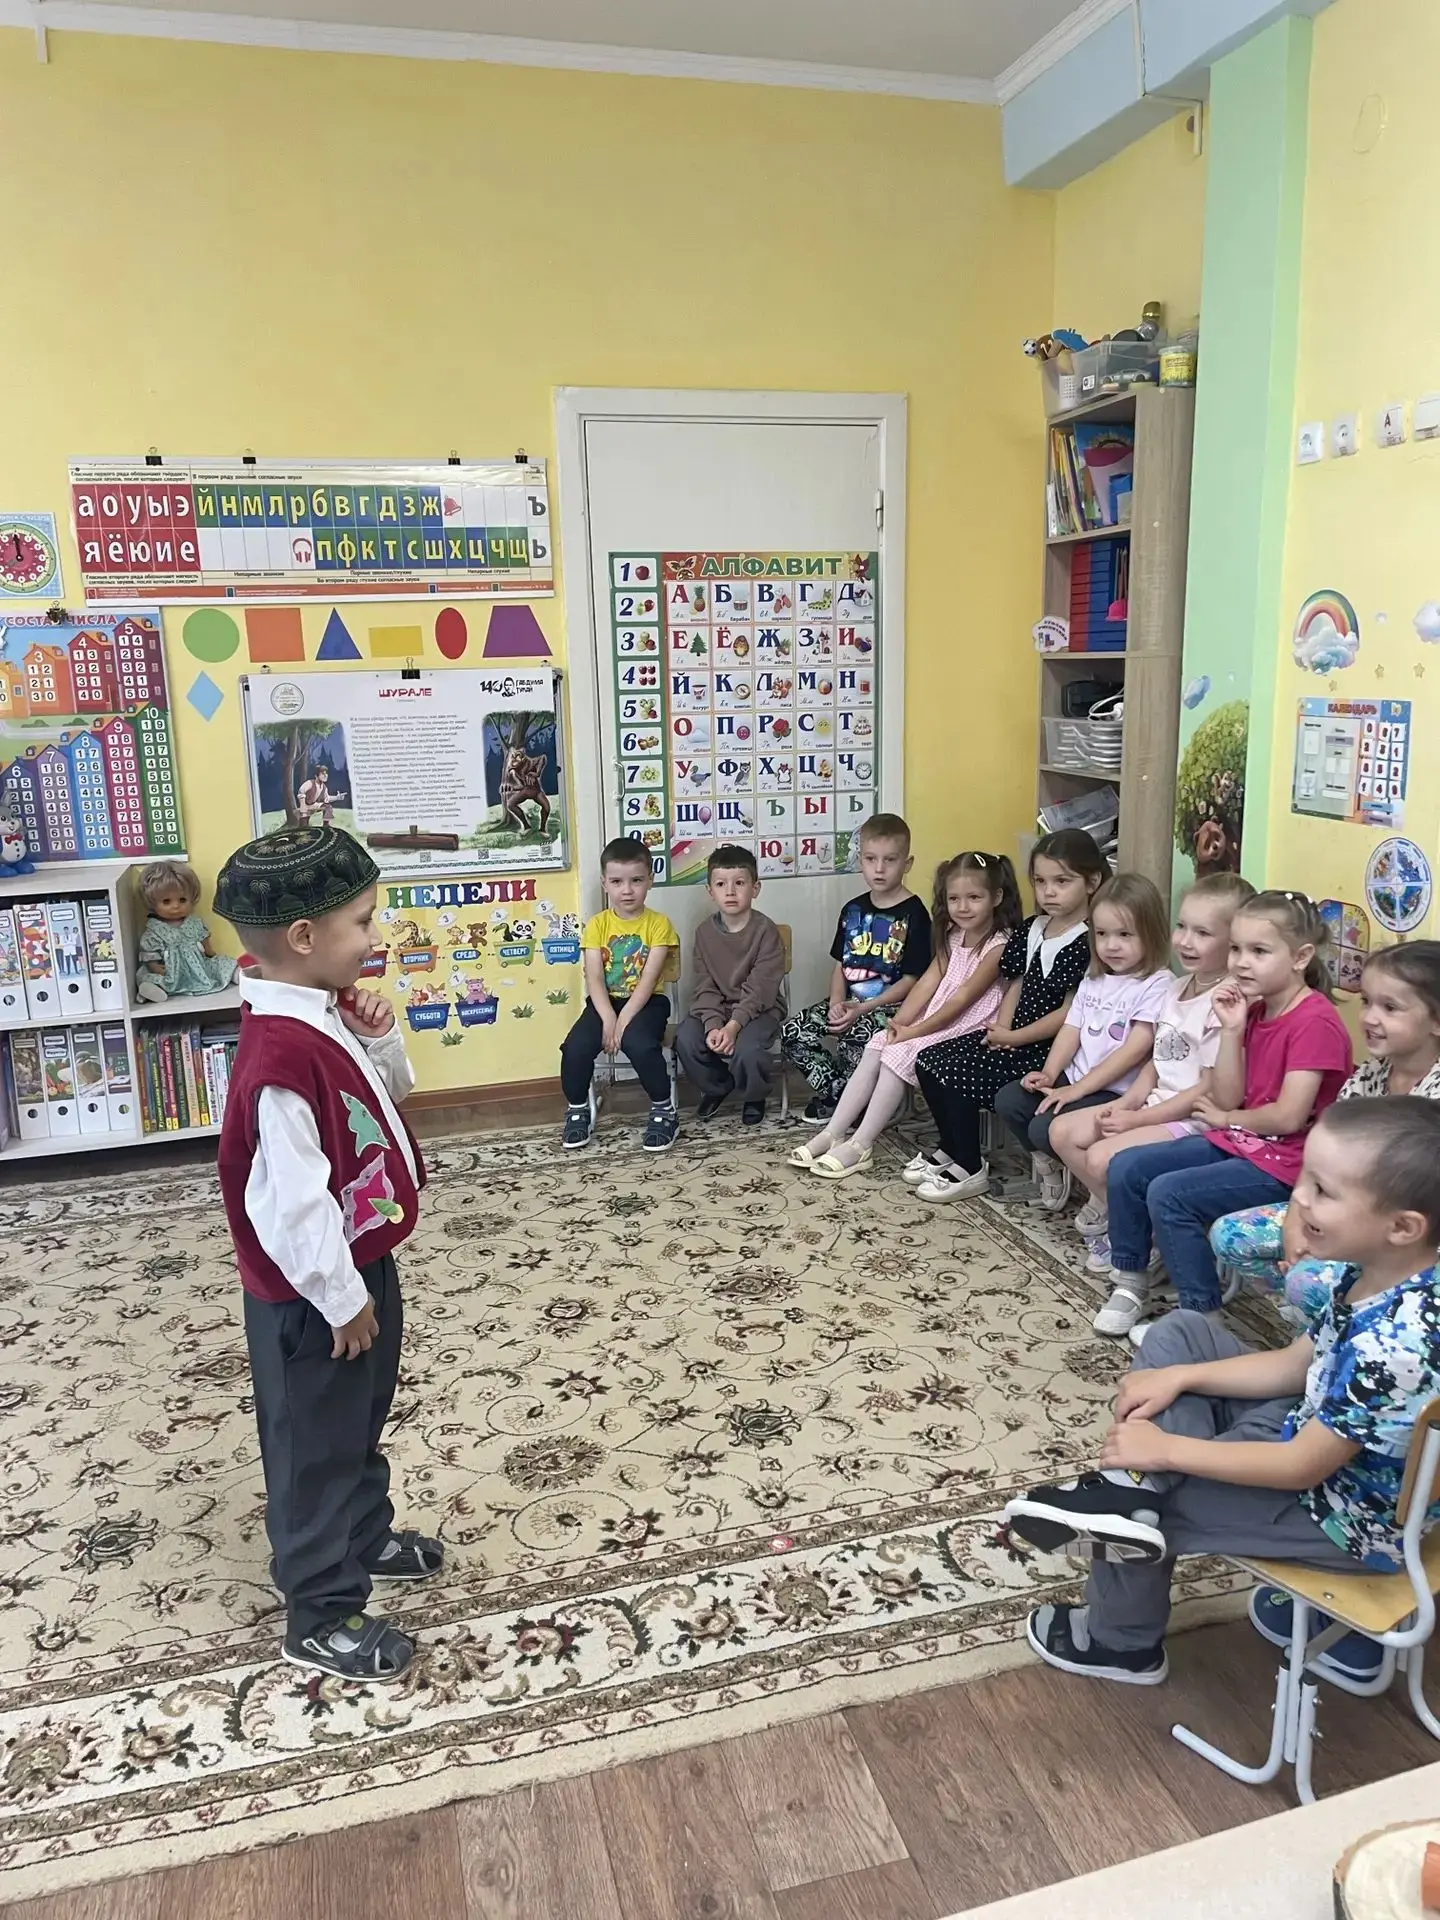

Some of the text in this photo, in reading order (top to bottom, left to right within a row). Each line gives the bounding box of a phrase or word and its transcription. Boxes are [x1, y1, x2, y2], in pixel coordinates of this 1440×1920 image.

[620, 562, 630, 582] 1
[700, 556, 842, 577] АЛФАВИТ
[671, 583, 855, 604] А Б В Г Д
[619, 598, 634, 616] 2
[6, 614, 117, 627] СОСТА ЧИСЛА
[125, 623, 134, 634] 5
[78, 637, 87, 649] 4
[621, 632, 635, 650] 3
[672, 626, 855, 649] Е Ё Ж З И
[34, 651, 43, 663] 3
[137, 663, 144, 671] 2
[125, 677, 132, 685] 4
[622, 666, 635, 684] 4
[79, 678, 85, 686] 3
[672, 671, 856, 694] Й К Л М Н
[80, 691, 87, 699] 4
[127, 690, 134, 698] 5
[379, 688, 432, 697] ШУРАЛЕ
[144, 708, 158, 719] 10
[623, 700, 636, 717] 5
[114, 722, 123, 733] 9
[674, 712, 853, 736] О П Р С Т
[81, 736, 90, 748] 8
[623, 733, 636, 751] 6
[47, 752, 55, 762] 7
[12, 766, 21, 777] 6
[675, 754, 854, 778] У Ф Х Ц Ч
[627, 766, 640, 783] 7
[627, 798, 640, 815] 8
[677, 795, 864, 822] Ш Щ Ъ Ы Ь
[760, 838, 816, 858] Ю Я
[652, 858, 664, 874] 0
[386, 879, 537, 909] НЕДЕЛИ
[455, 950, 478, 960] СРЕДА
[502, 946, 529, 957] ЧЕТВЕРГ
[549, 945, 576, 954] ПЯТНИЦА
[403, 954, 430, 964] ВТОРНИК
[415, 1011, 442, 1021] СУББОТА
